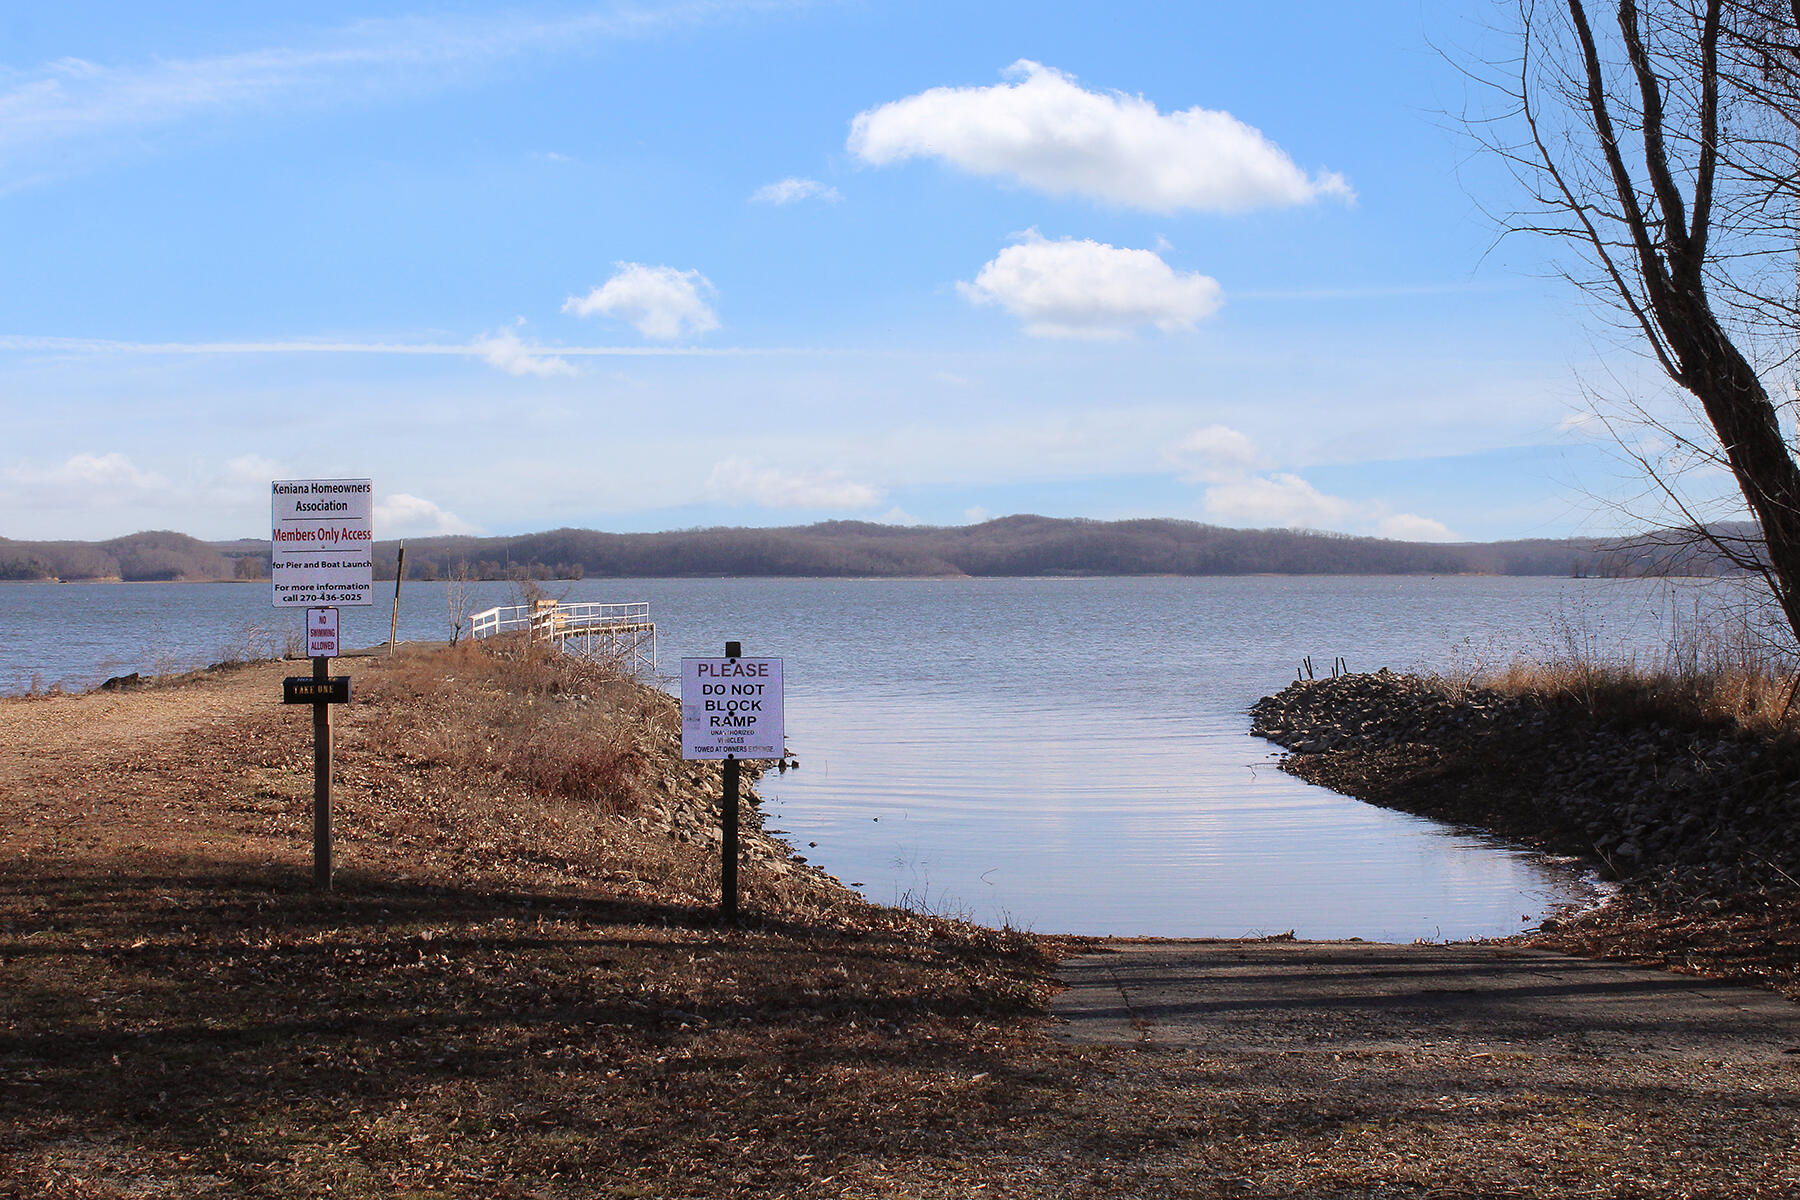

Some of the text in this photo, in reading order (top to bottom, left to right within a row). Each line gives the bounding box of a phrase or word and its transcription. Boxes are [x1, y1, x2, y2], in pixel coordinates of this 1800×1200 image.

[273, 483, 371, 494] Keniana Homeowners
[296, 500, 348, 511] Association
[273, 527, 372, 544] Members Only Access
[272, 561, 285, 569] for
[286, 561, 302, 569] Pier
[342, 560, 372, 568] Launch
[316, 583, 370, 591] information
[282, 593, 362, 602] call 270-436-5025
[319, 615, 327, 624] NO
[310, 628, 335, 637] SWIMMING
[311, 641, 335, 650] ALLOWED
[697, 663, 769, 677] PLEASE
[293, 684, 334, 695] TAKE ONE
[702, 684, 765, 695] DO NOT
[705, 700, 762, 711] BLOCK
[710, 716, 757, 727] RAMP
